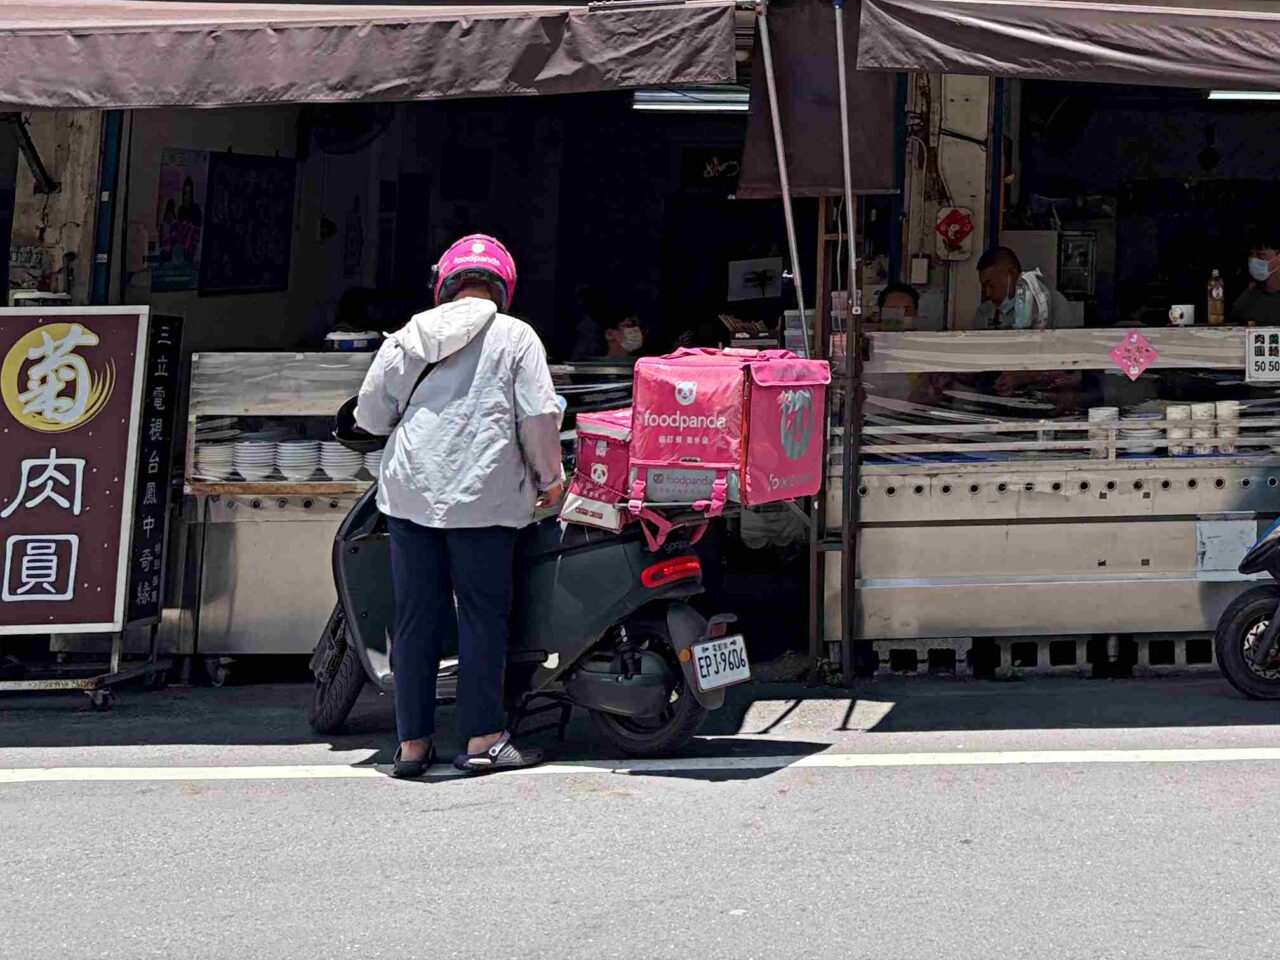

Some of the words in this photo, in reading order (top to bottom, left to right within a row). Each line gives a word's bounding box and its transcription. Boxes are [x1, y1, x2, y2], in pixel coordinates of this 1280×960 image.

[1254, 360, 1266, 372] 50
[1268, 360, 1280, 372] 50
[643, 409, 727, 432] foodpanda
[1, 447, 87, 602] 肉圓
[698, 646, 746, 679] EPJ-9606
